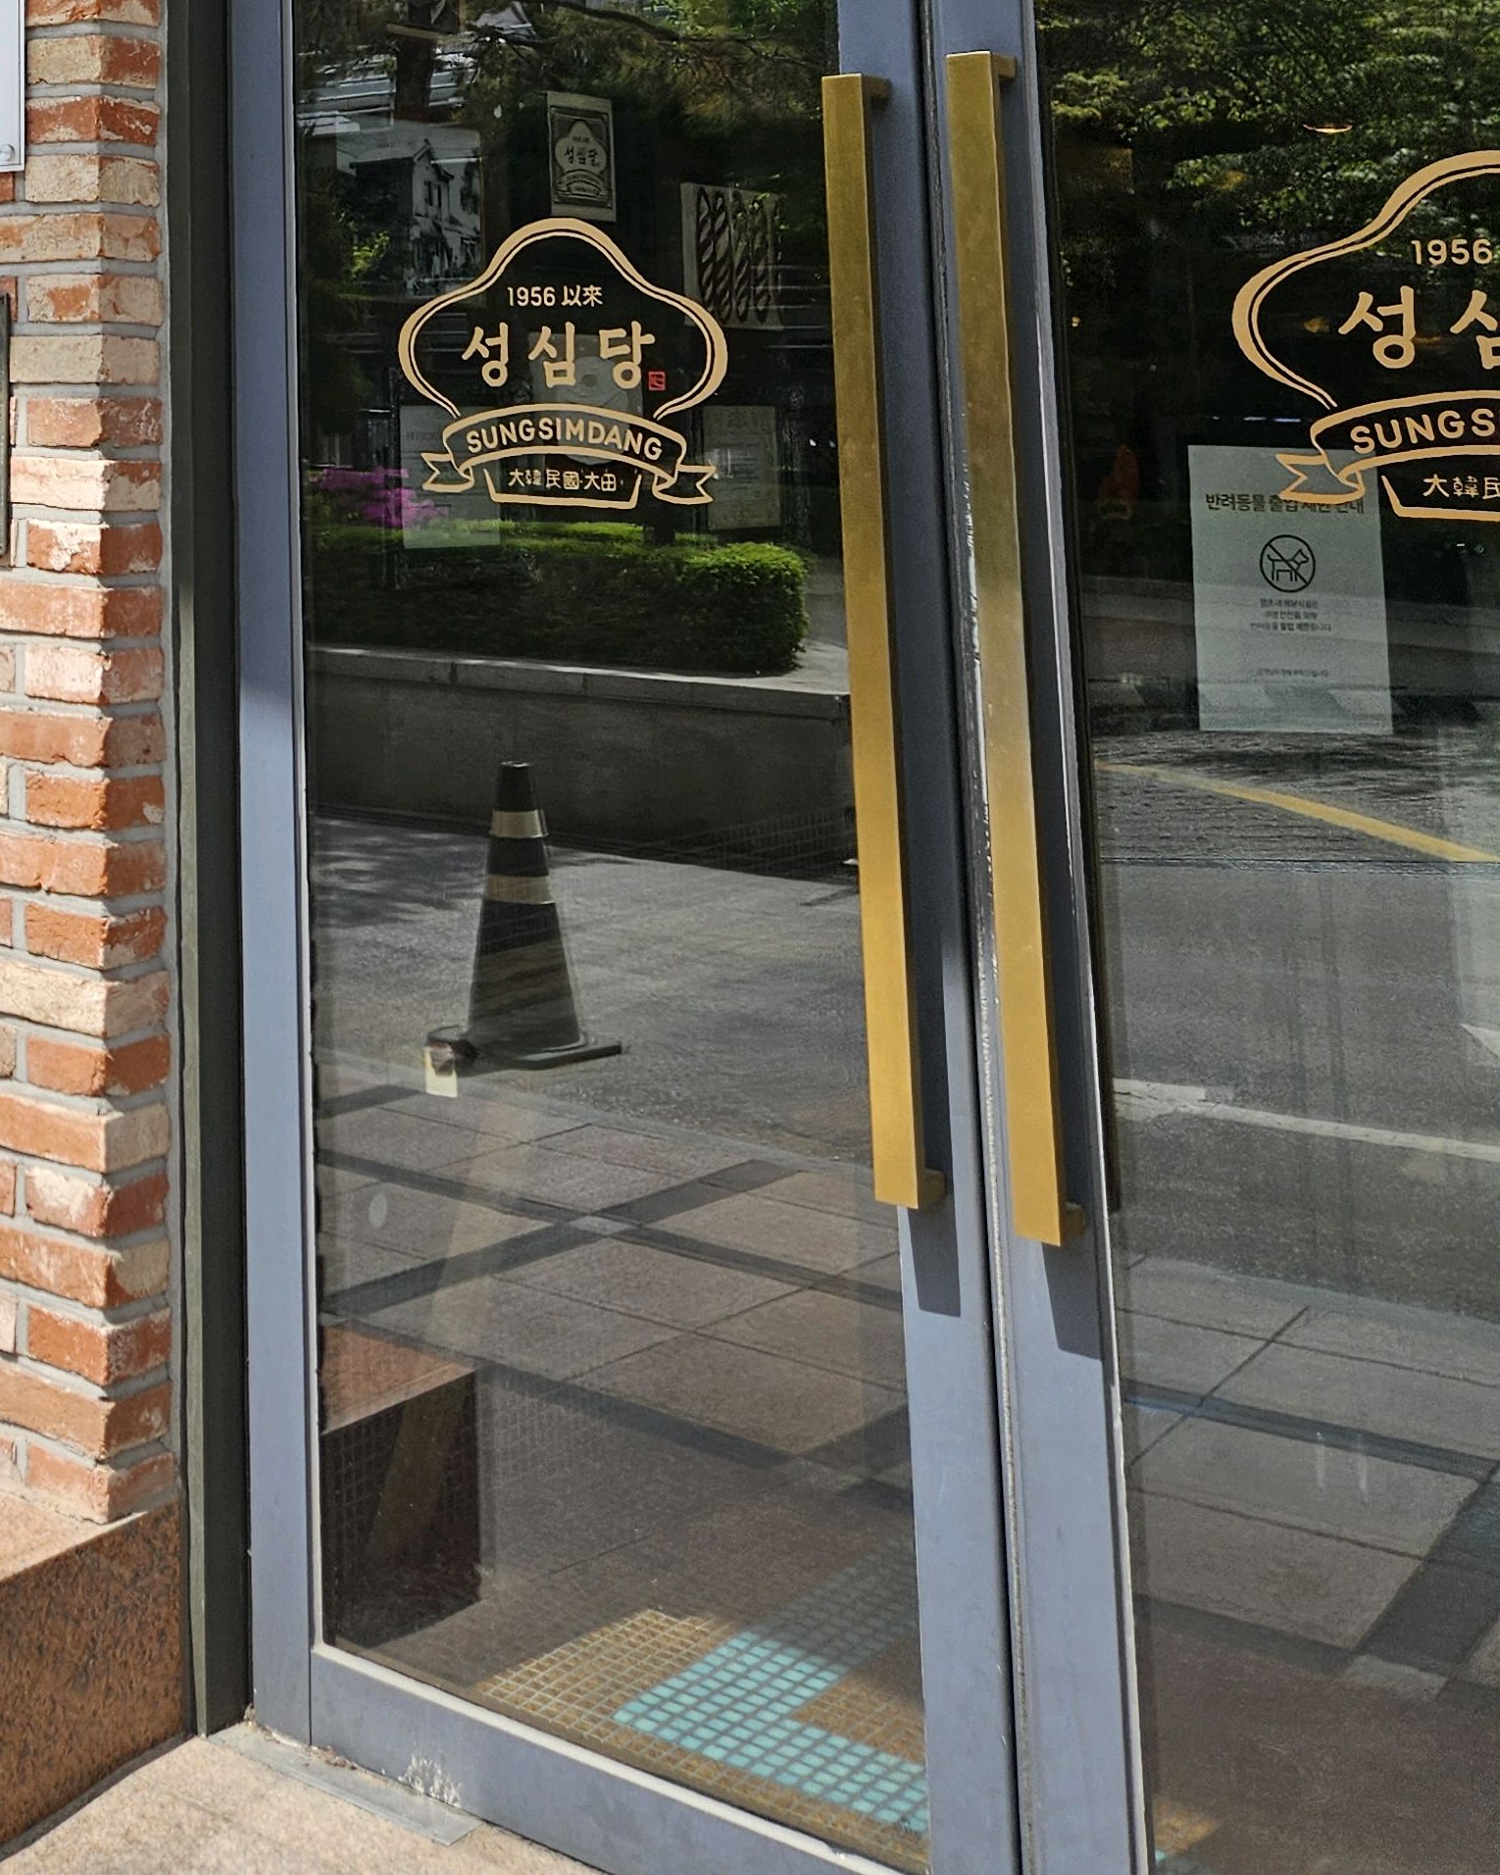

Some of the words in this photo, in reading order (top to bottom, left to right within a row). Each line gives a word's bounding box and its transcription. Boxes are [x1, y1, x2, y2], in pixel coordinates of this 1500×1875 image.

[1411, 239, 1493, 266] 1956
[507, 286, 556, 307] 1956
[561, 285, 603, 307] 以來
[461, 321, 656, 389] 성심당
[466, 418, 663, 461] SUNGSIMDANG
[1350, 408, 1496, 455] SUNGS
[1205, 493, 1266, 512] 반려동물
